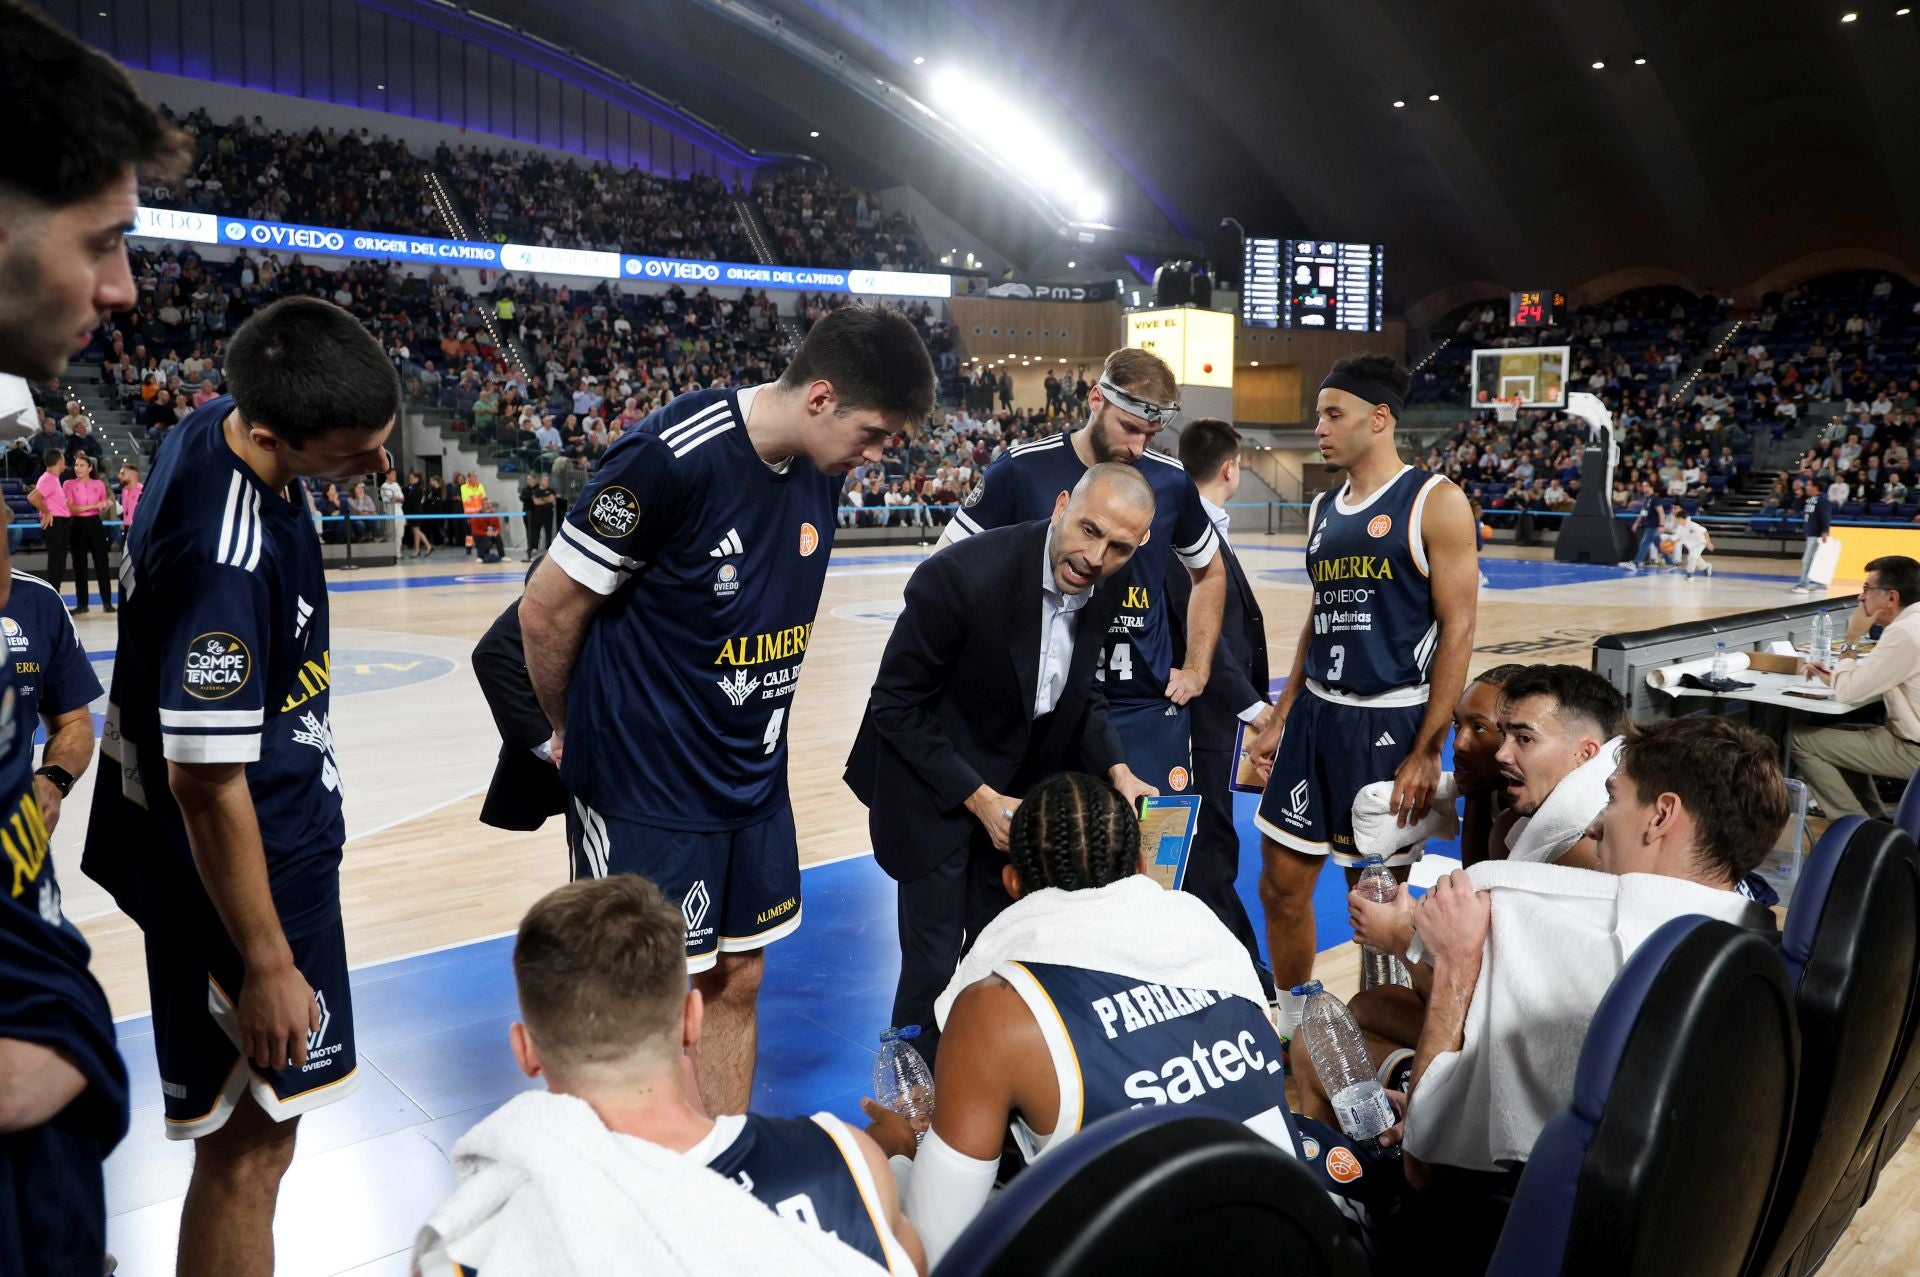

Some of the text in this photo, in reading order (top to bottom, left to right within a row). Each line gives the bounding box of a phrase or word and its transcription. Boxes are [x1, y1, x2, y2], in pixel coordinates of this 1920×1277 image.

[251, 225, 496, 260] OVIEDO ORIGEN DEL CAMINO
[645, 260, 844, 285] OVIEDO ORIGEN DEL CAMINO
[1516, 305, 1542, 323] 24
[1135, 320, 1159, 329] VIVE
[1141, 340, 1155, 348] EN
[714, 582, 739, 591] OVIEDO
[1332, 610, 1371, 623] Asturias
[207, 640, 225, 655] La
[1326, 645, 1345, 681] 3
[186, 669, 241, 685] TENCIA
[763, 668, 790, 687] CAJA
[762, 689, 774, 700] DE
[762, 708, 785, 755] 4
[756, 896, 797, 925] ALIMERKA
[689, 927, 714, 938] MOTOR
[310, 1043, 342, 1060] MOTOR
[302, 1058, 332, 1073] OVIEDO
